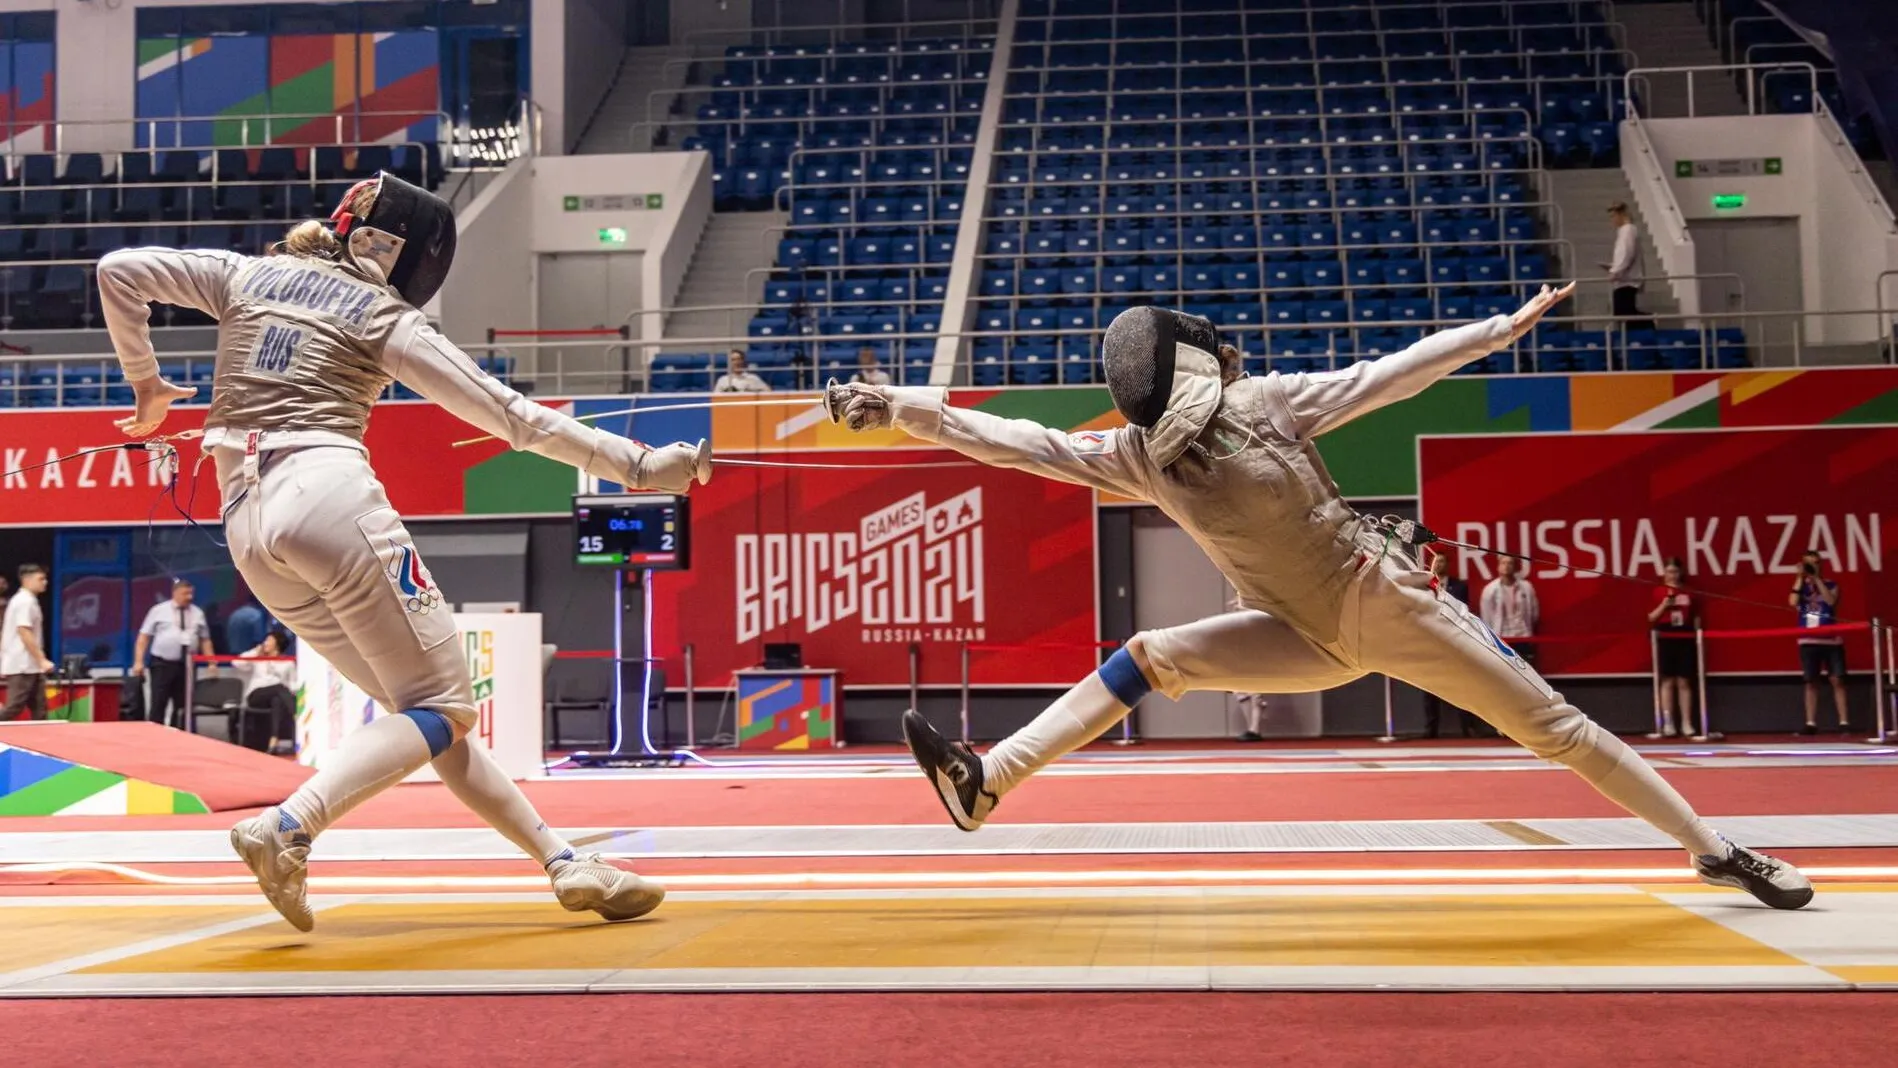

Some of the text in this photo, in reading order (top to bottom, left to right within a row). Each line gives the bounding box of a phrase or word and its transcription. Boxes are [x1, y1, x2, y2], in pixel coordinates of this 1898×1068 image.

[256, 325, 302, 373] RUS
[4, 447, 171, 490] KAZAN
[661, 534, 674, 550] 2
[866, 501, 921, 543] GAMES
[579, 536, 604, 552] 15
[1456, 513, 1882, 580] RUSSIA KAZAN
[736, 525, 985, 644] BRICS 2024
